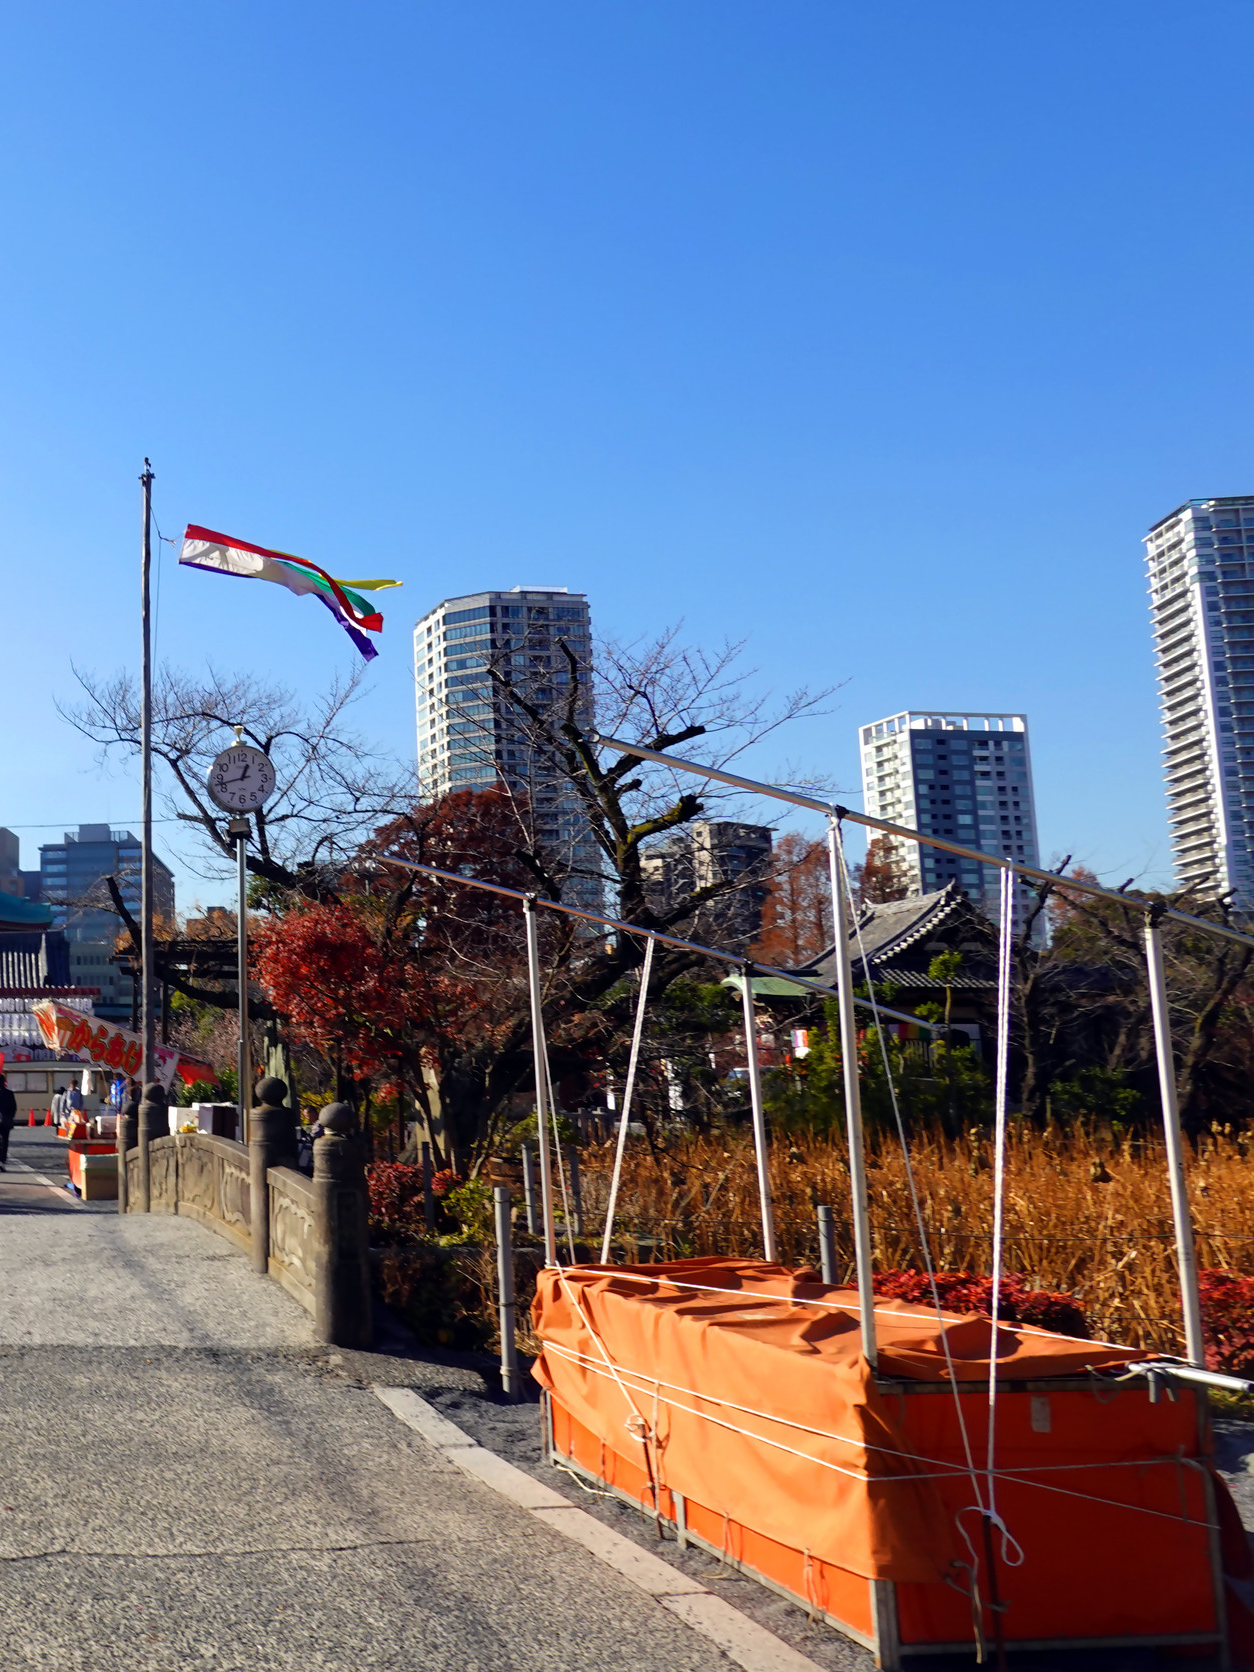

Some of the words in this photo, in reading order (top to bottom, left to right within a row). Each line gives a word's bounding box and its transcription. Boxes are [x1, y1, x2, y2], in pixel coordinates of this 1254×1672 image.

[227, 754, 236, 764] 11
[237, 752, 248, 763] 12
[251, 755, 255, 764] 1
[218, 763, 229, 773] 10
[258, 762, 265, 772] 2
[216, 773, 224, 784] 9
[261, 773, 268, 783] 3
[220, 783, 228, 793] 8
[258, 784, 265, 793] 4
[229, 792, 236, 801] 7
[239, 794, 246, 804] 6
[249, 792, 257, 801] 5
